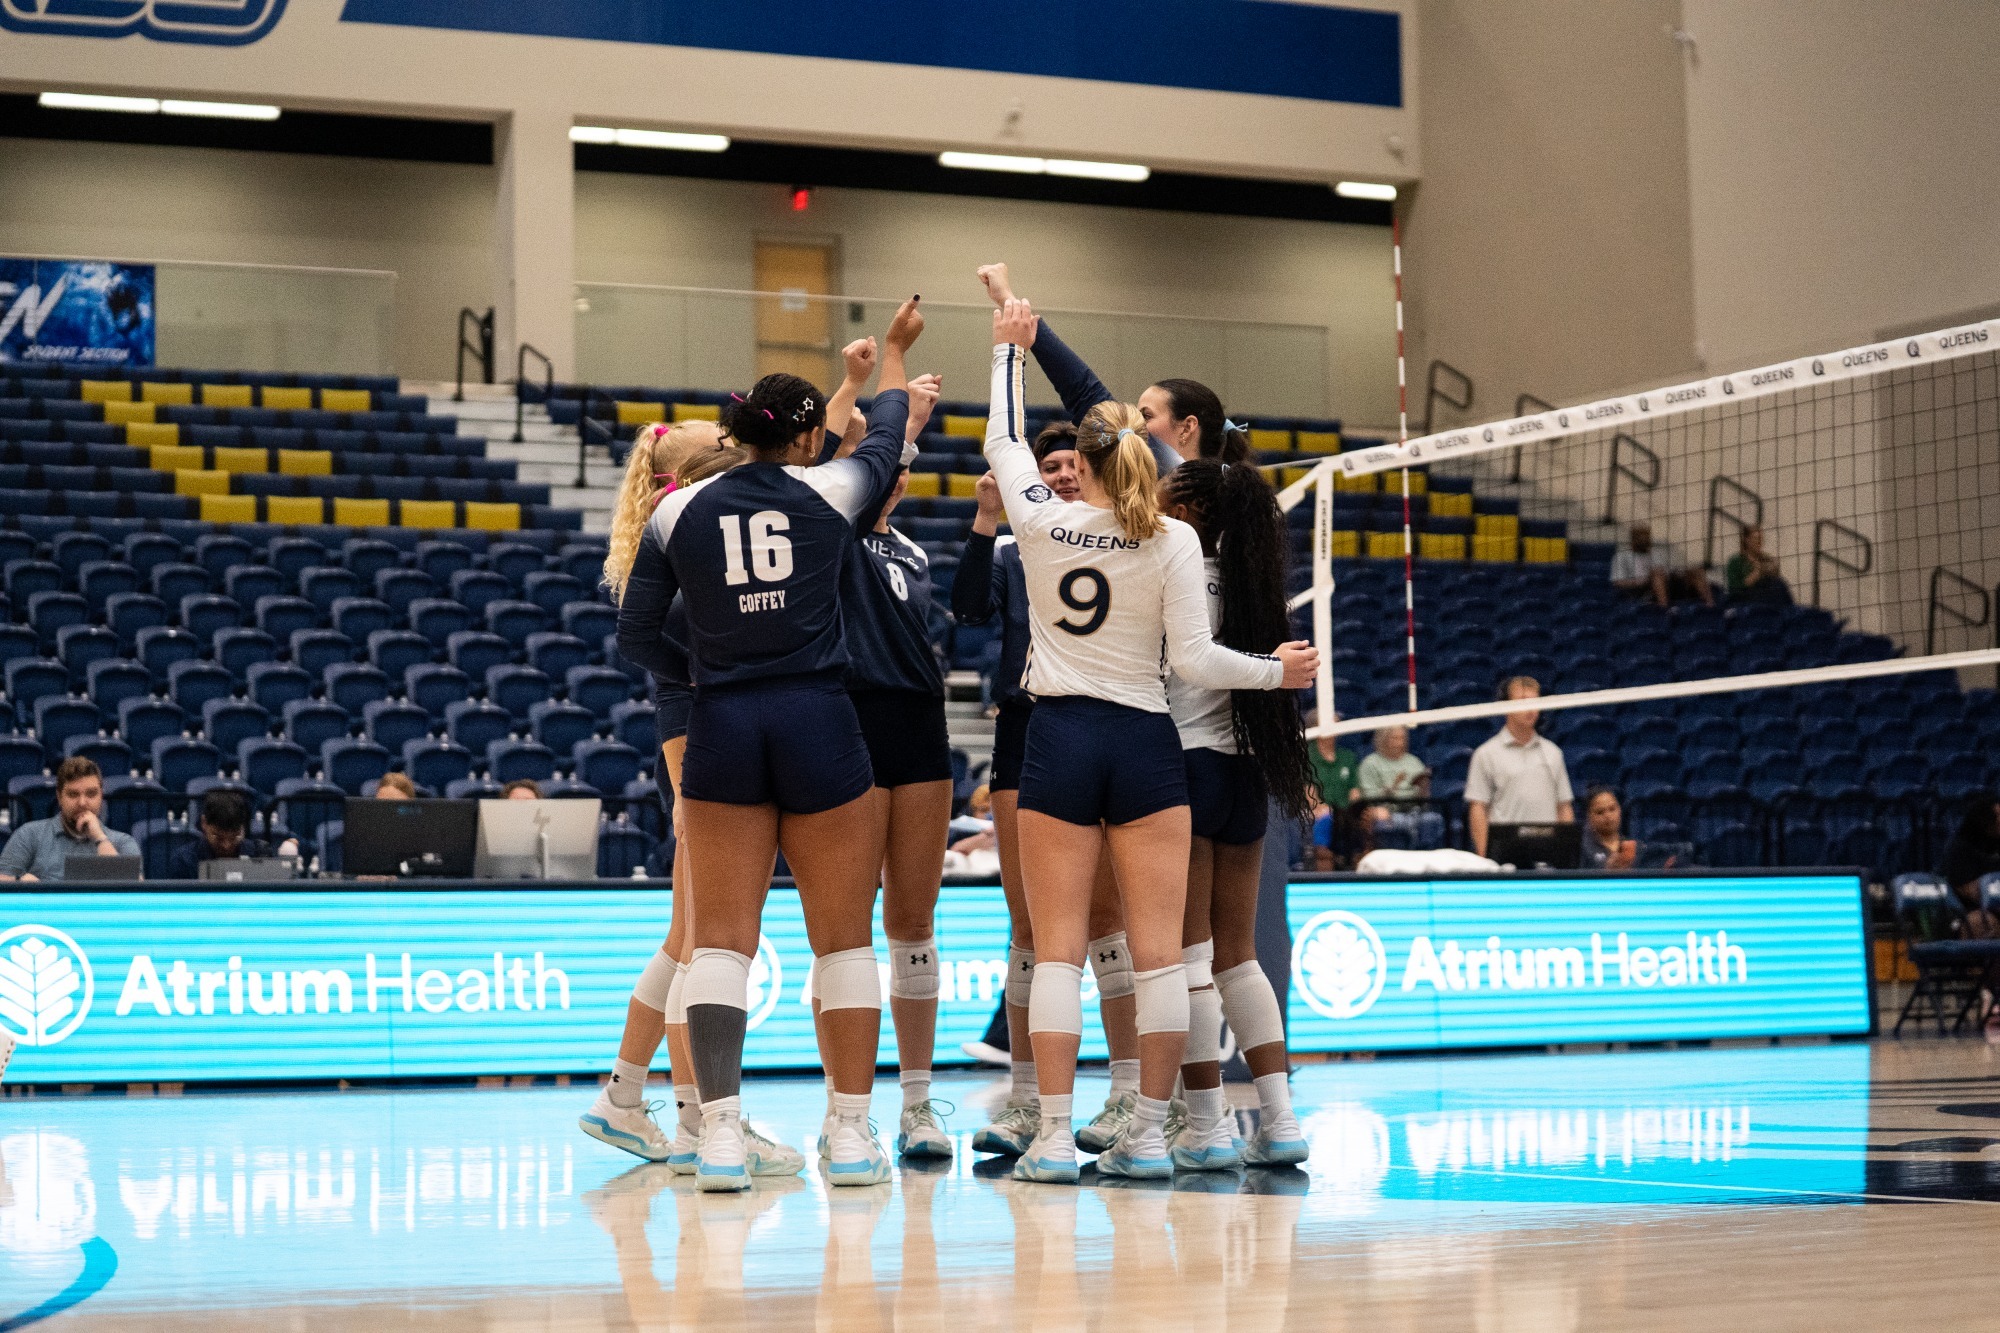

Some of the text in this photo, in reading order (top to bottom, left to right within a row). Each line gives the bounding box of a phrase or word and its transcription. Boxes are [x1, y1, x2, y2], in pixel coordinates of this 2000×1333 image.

[1436, 435, 1470, 450] QUEENS
[1508, 419, 1544, 436] QUEENS
[1586, 403, 1624, 421] QUEENS
[1666, 387, 1707, 403] QUEENS
[1752, 367, 1794, 386] QUEENS
[1843, 348, 1889, 368] QUEENS
[1940, 330, 1989, 349] QUEENS
[718, 510, 794, 586] 16
[738, 590, 786, 614] COFFEY
[886, 562, 909, 602] 8
[1052, 566, 1113, 637] 9
[116, 950, 571, 1016] Atrium Health
[1402, 930, 1748, 992] Atrium Health
